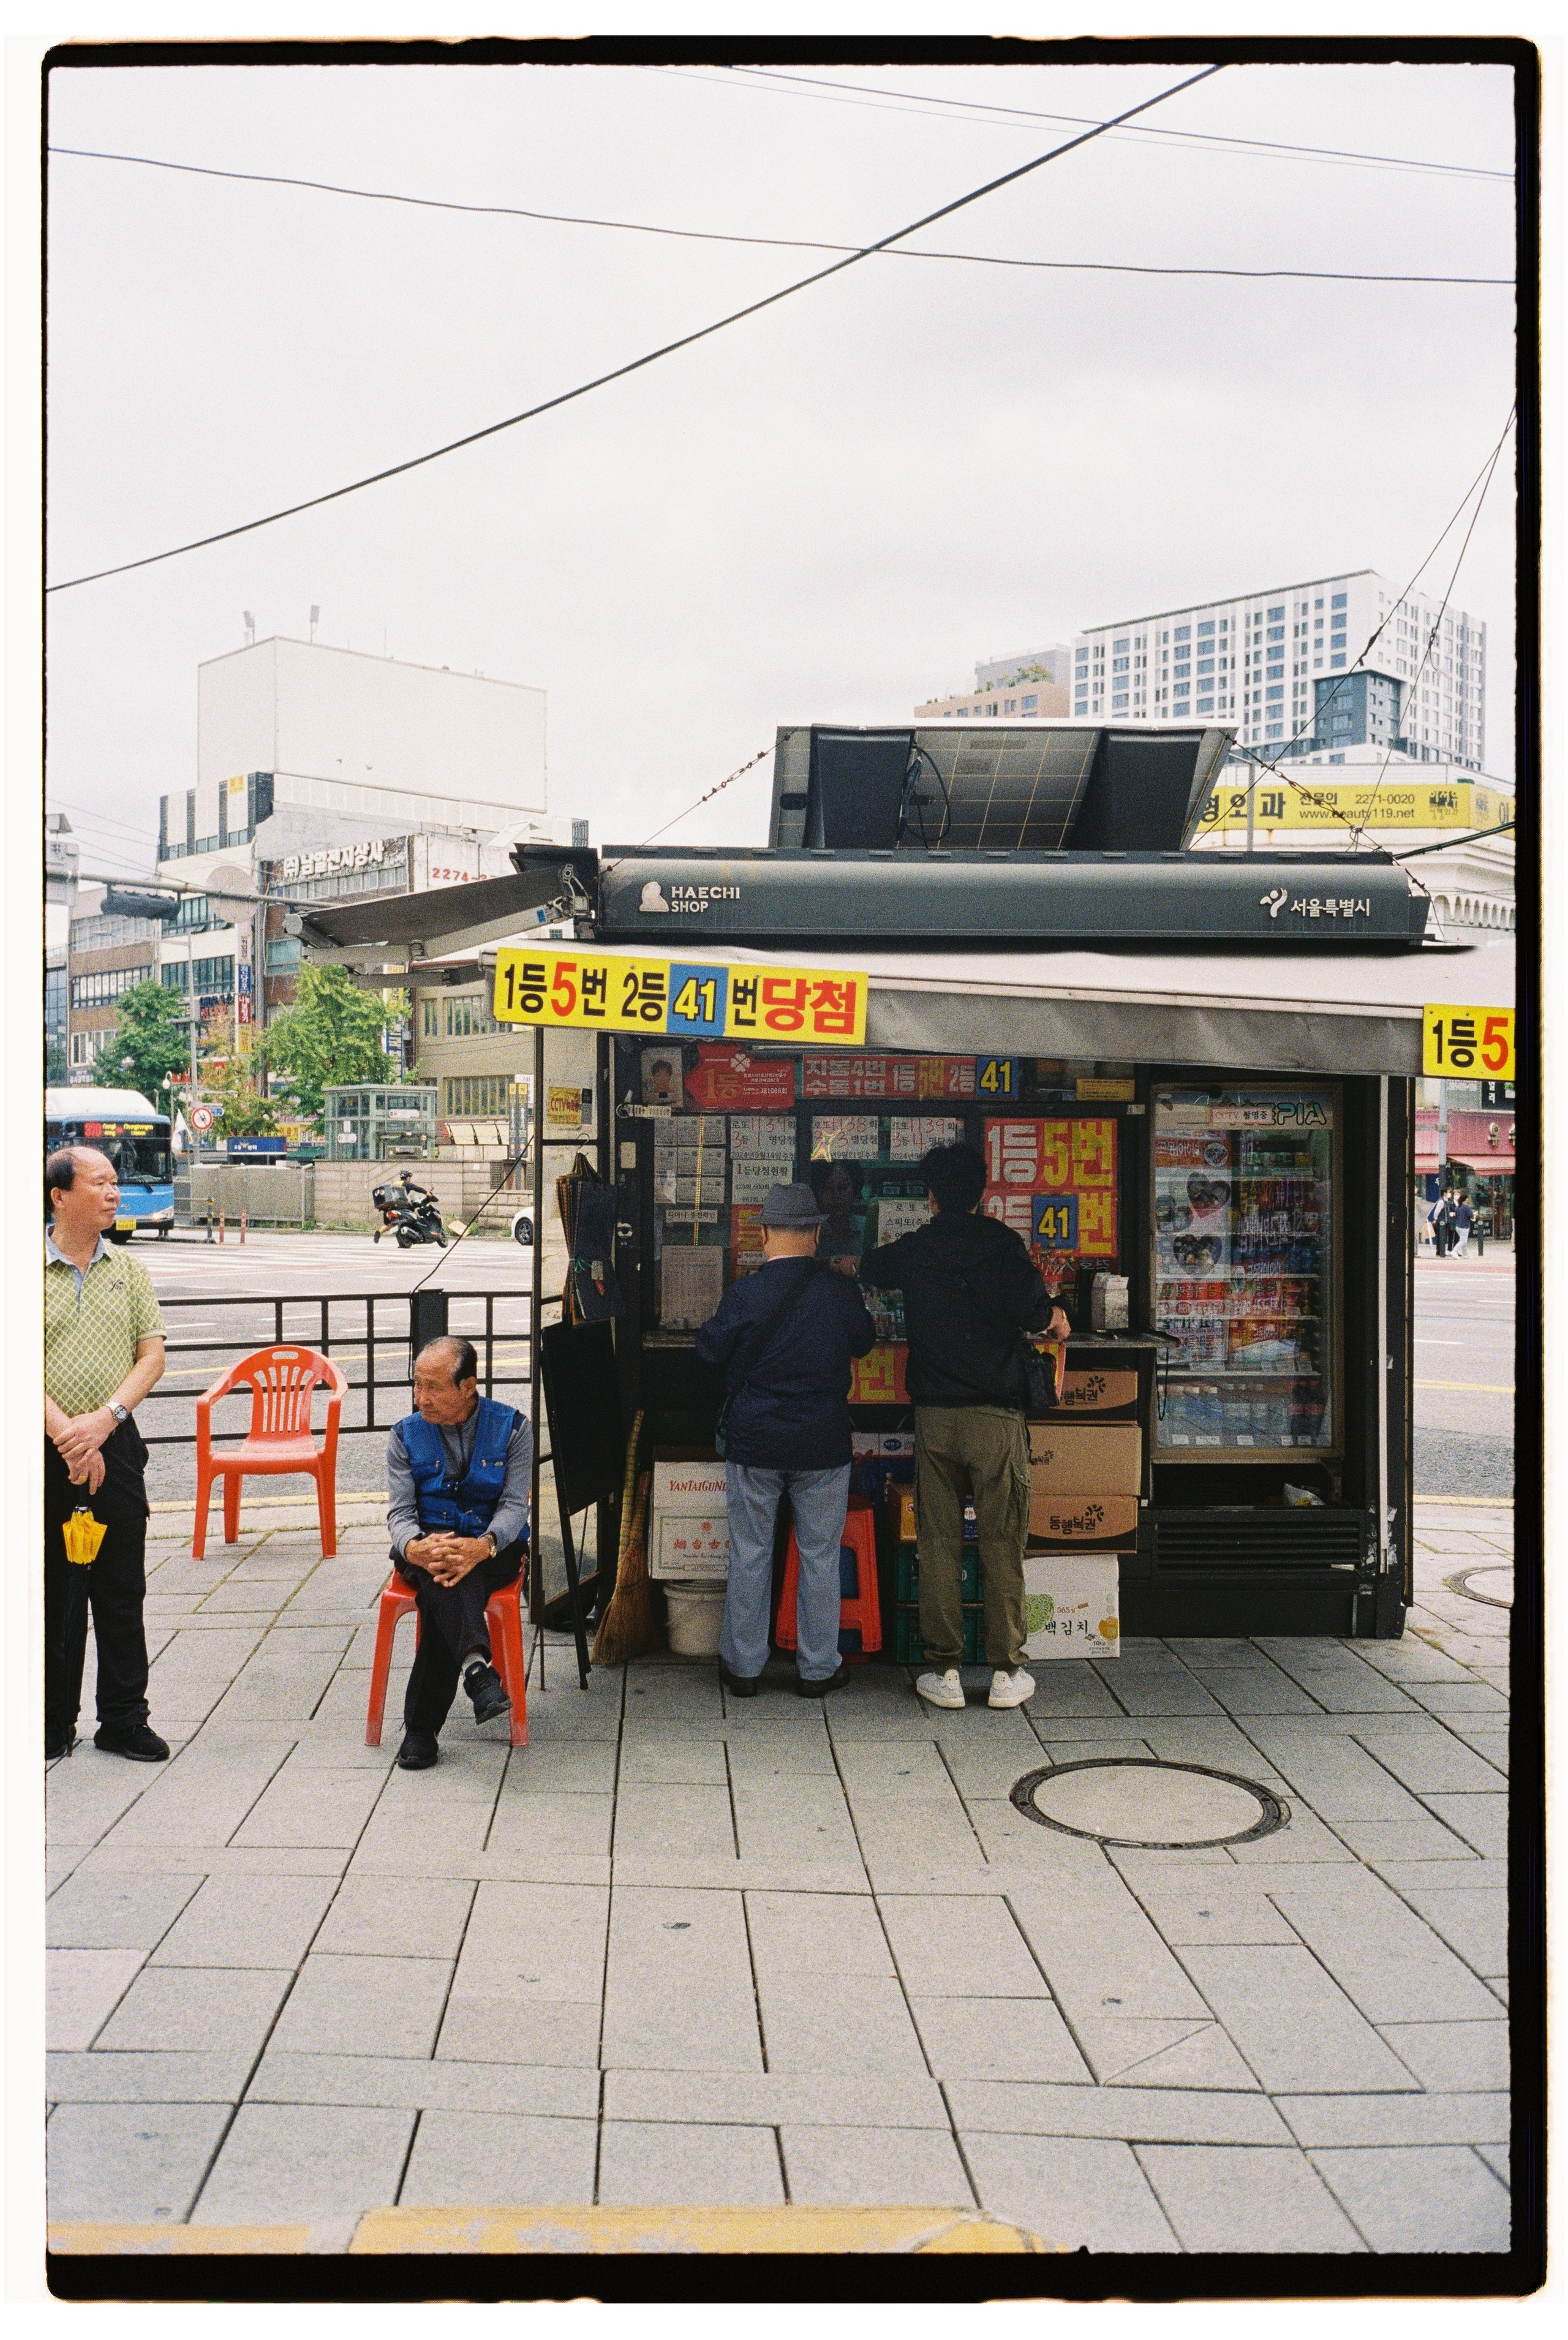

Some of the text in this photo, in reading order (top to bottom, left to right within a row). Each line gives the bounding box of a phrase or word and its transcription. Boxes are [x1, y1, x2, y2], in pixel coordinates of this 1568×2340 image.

[1355, 794, 1415, 804] 2271-0020
[1300, 808, 1415, 821] www.eauty119.net
[432, 867, 497, 882] 2274-
[671, 886, 741, 899] HAECHI
[671, 901, 709, 913] SHOP
[1290, 897, 1371, 917] 서울특별시
[704, 1069, 741, 1098] 1등
[1243, 1111, 1268, 1119] 촬영중
[1050, 1516, 1096, 1534] 동행복권
